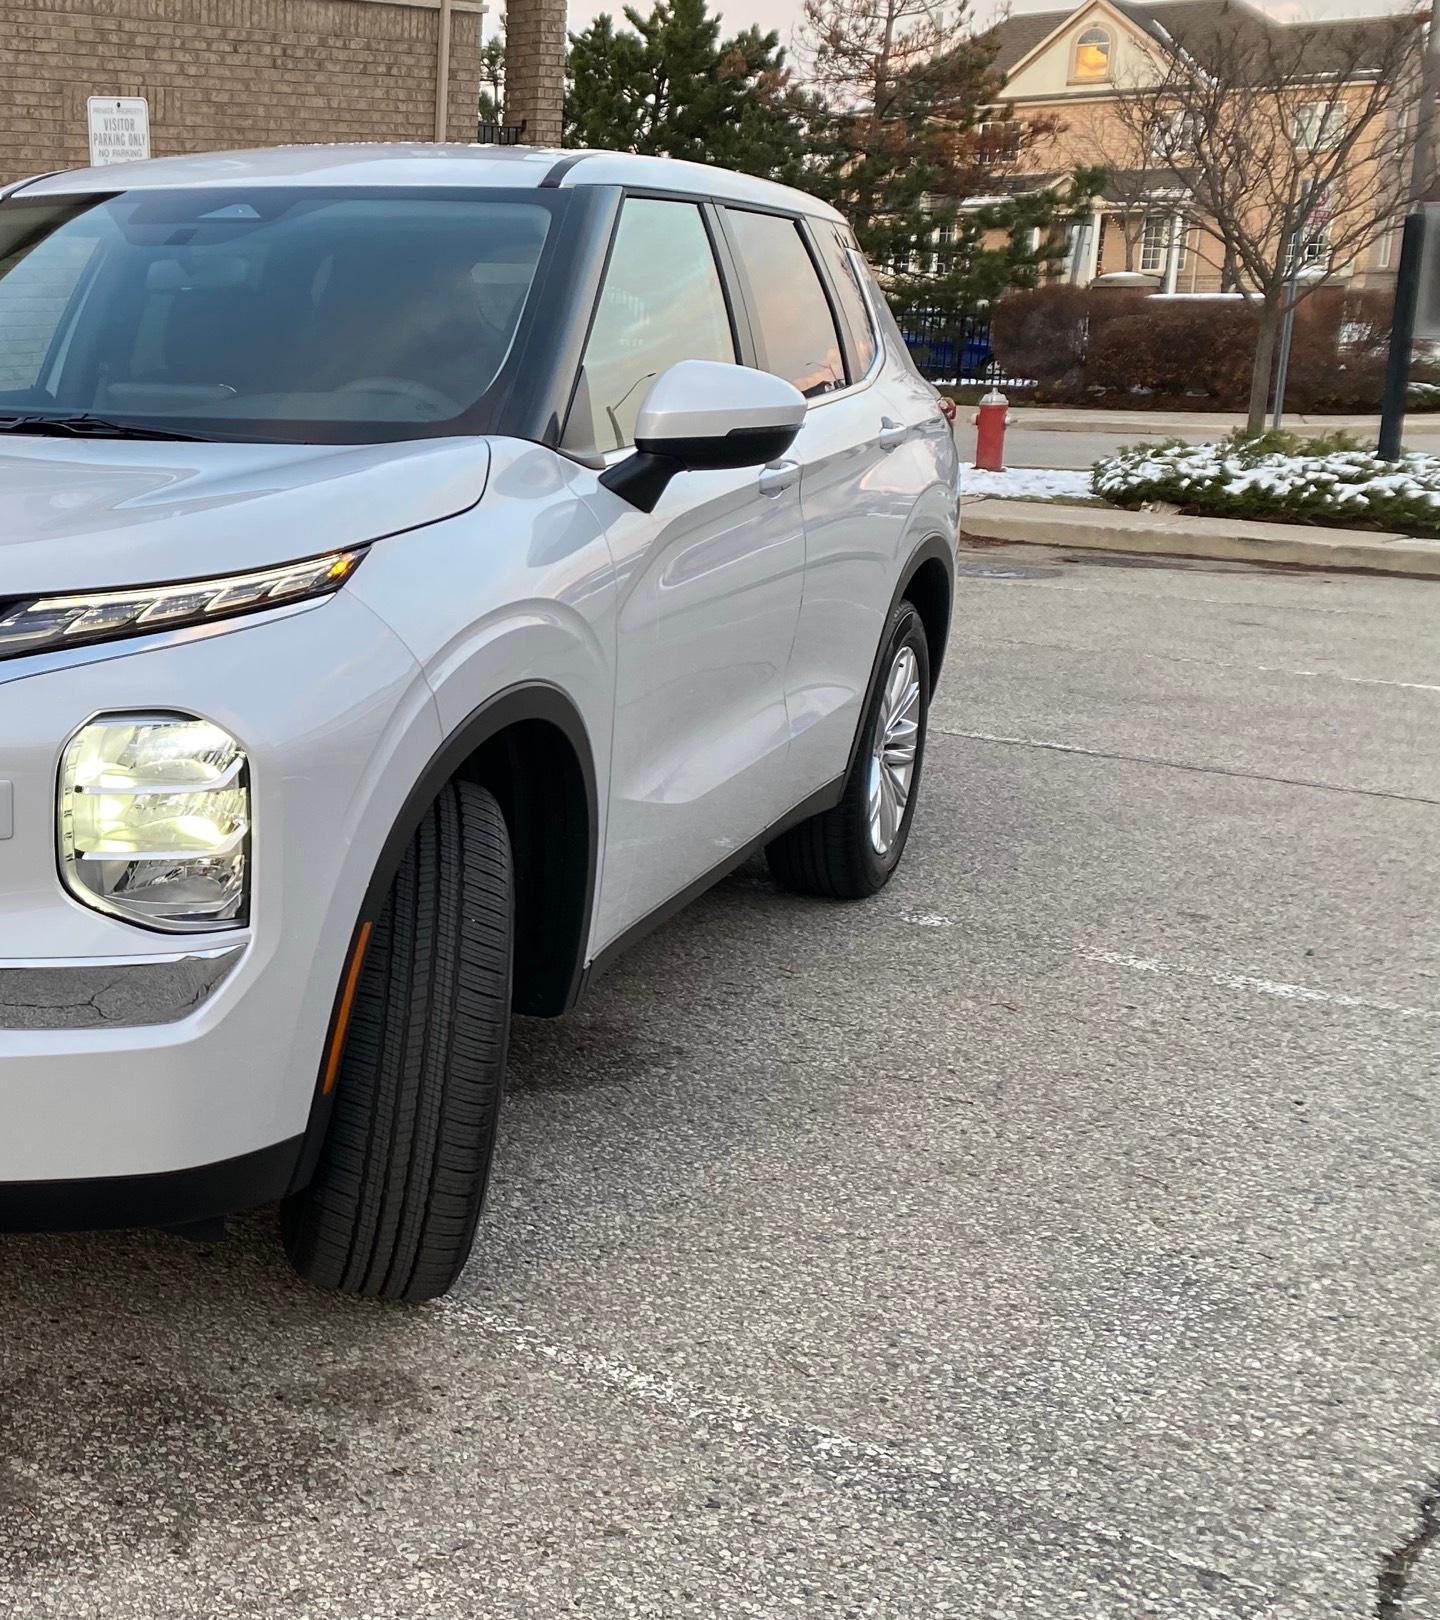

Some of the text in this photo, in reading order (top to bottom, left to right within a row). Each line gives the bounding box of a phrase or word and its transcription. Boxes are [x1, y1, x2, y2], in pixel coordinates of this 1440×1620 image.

[104, 118, 135, 131] VISITOR
[93, 133, 145, 146] PARKING ONLY
[99, 149, 142, 158] NO PARKING
